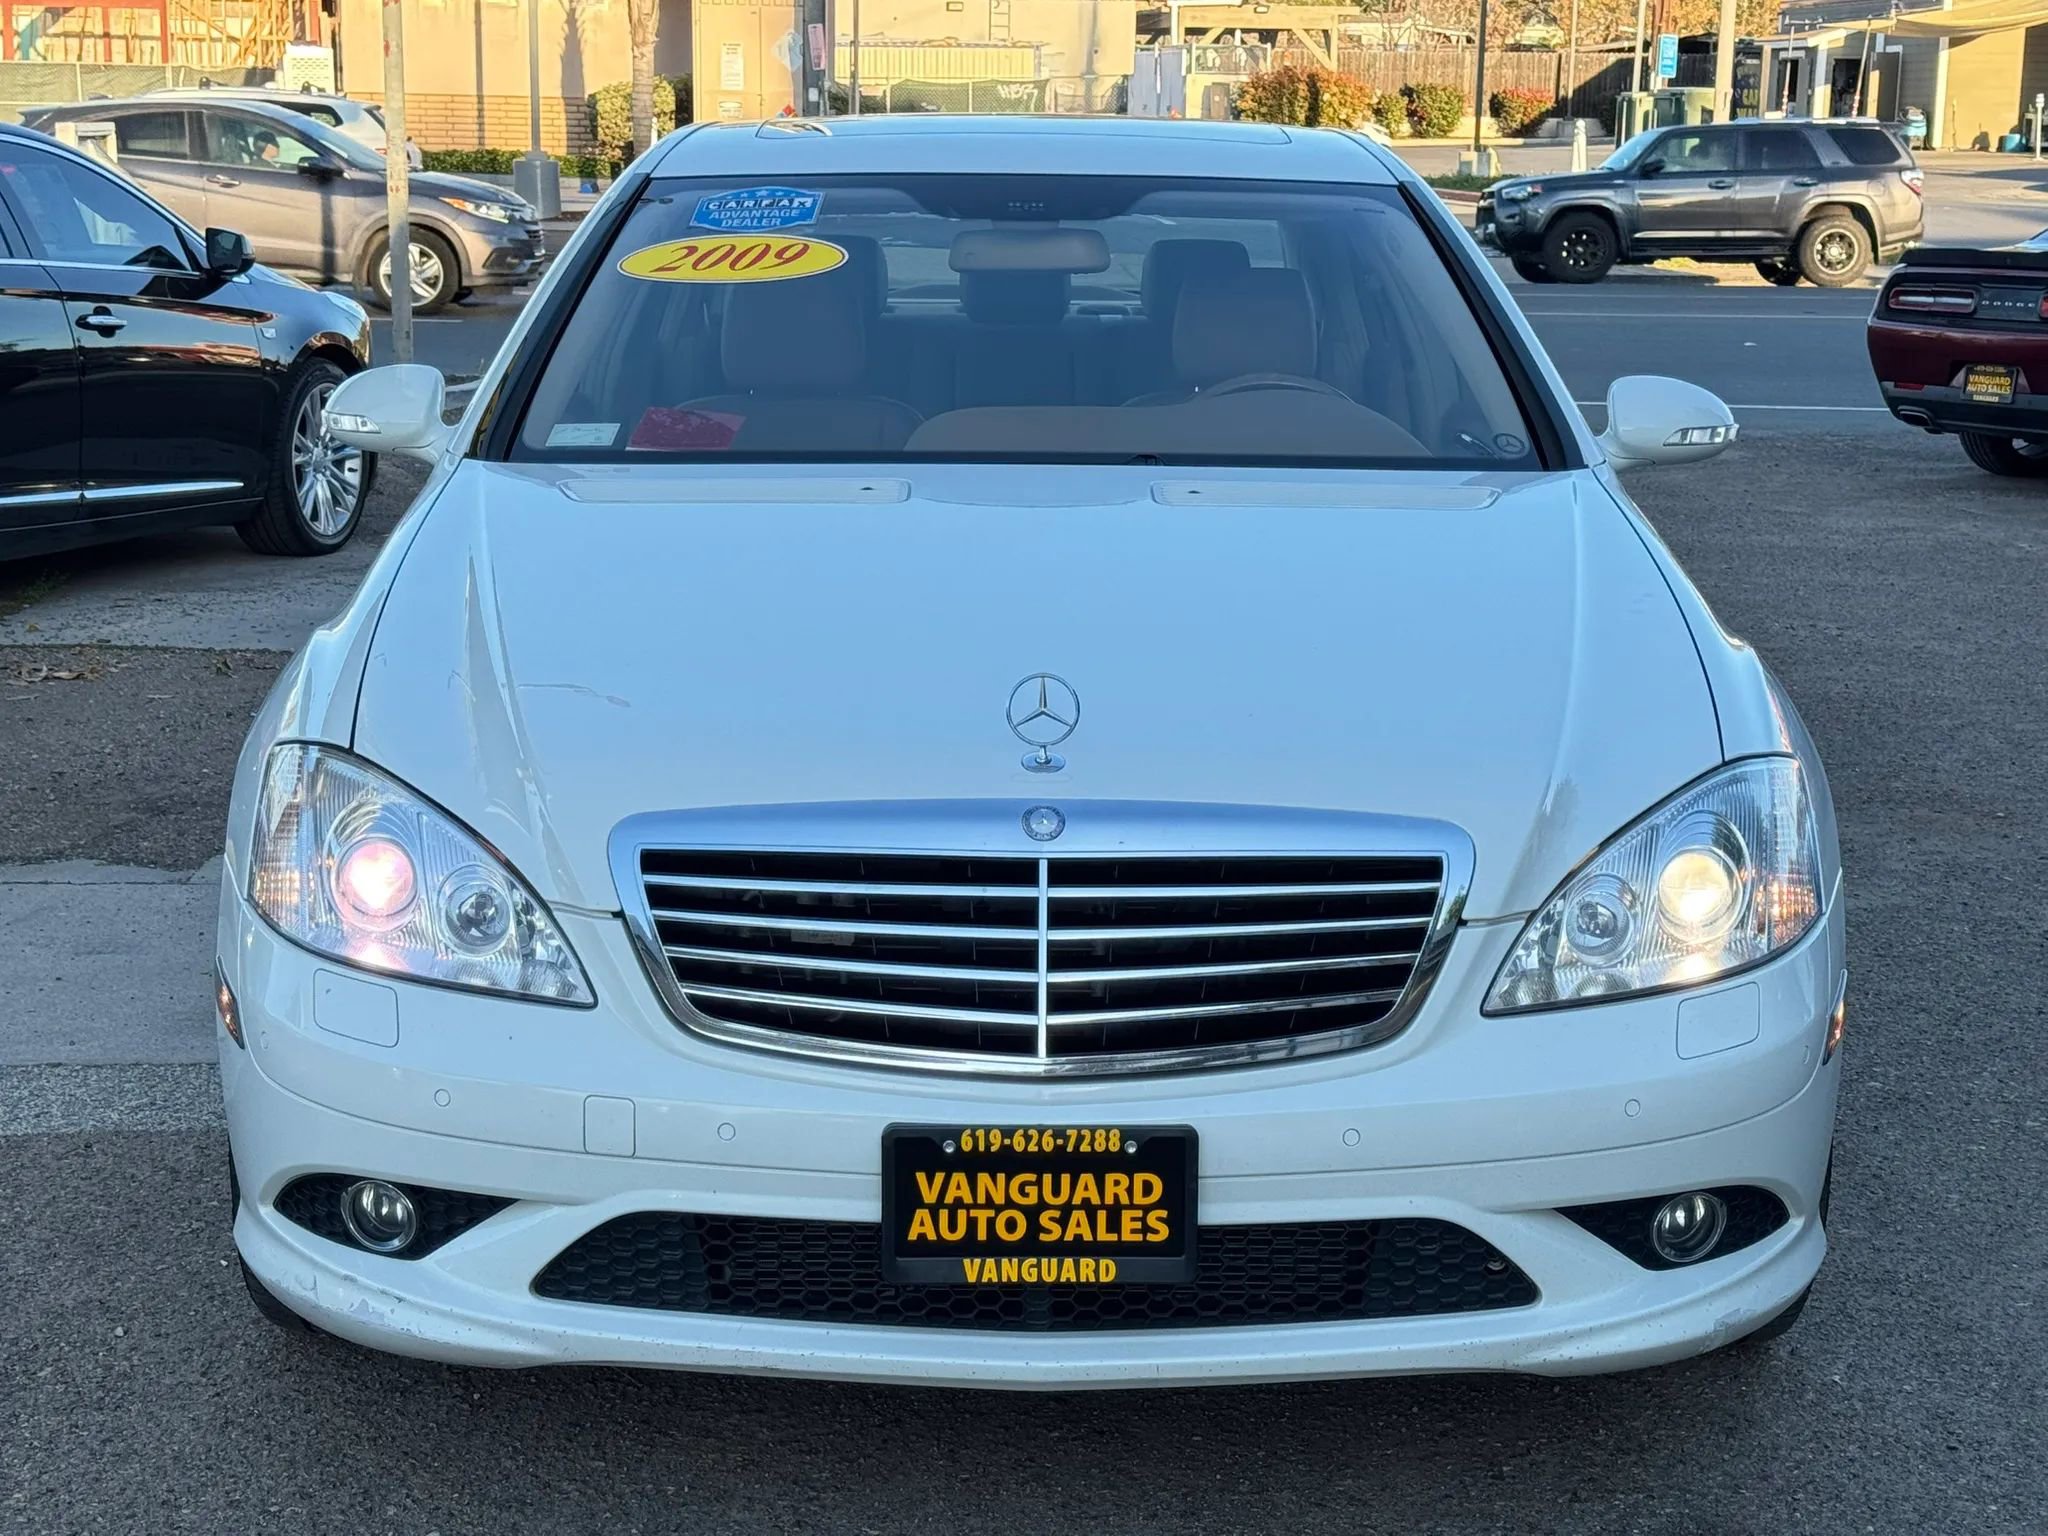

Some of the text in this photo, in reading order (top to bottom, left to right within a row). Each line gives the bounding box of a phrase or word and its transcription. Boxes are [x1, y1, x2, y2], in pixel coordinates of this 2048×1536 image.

[707, 198, 813, 209] CARFAX
[709, 209, 800, 219] ADVANTAGE
[721, 218, 781, 227] DEALER
[649, 243, 810, 273] 2009
[1967, 383, 2011, 394] AUTO SALES
[1969, 374, 2011, 386] VANGUARD
[960, 1128, 1121, 1152] 619-626-7288
[915, 1172, 1164, 1206] VANGUARD
[907, 1208, 1170, 1243] AUTO SALES
[963, 1258, 1117, 1283] VANGUARD
